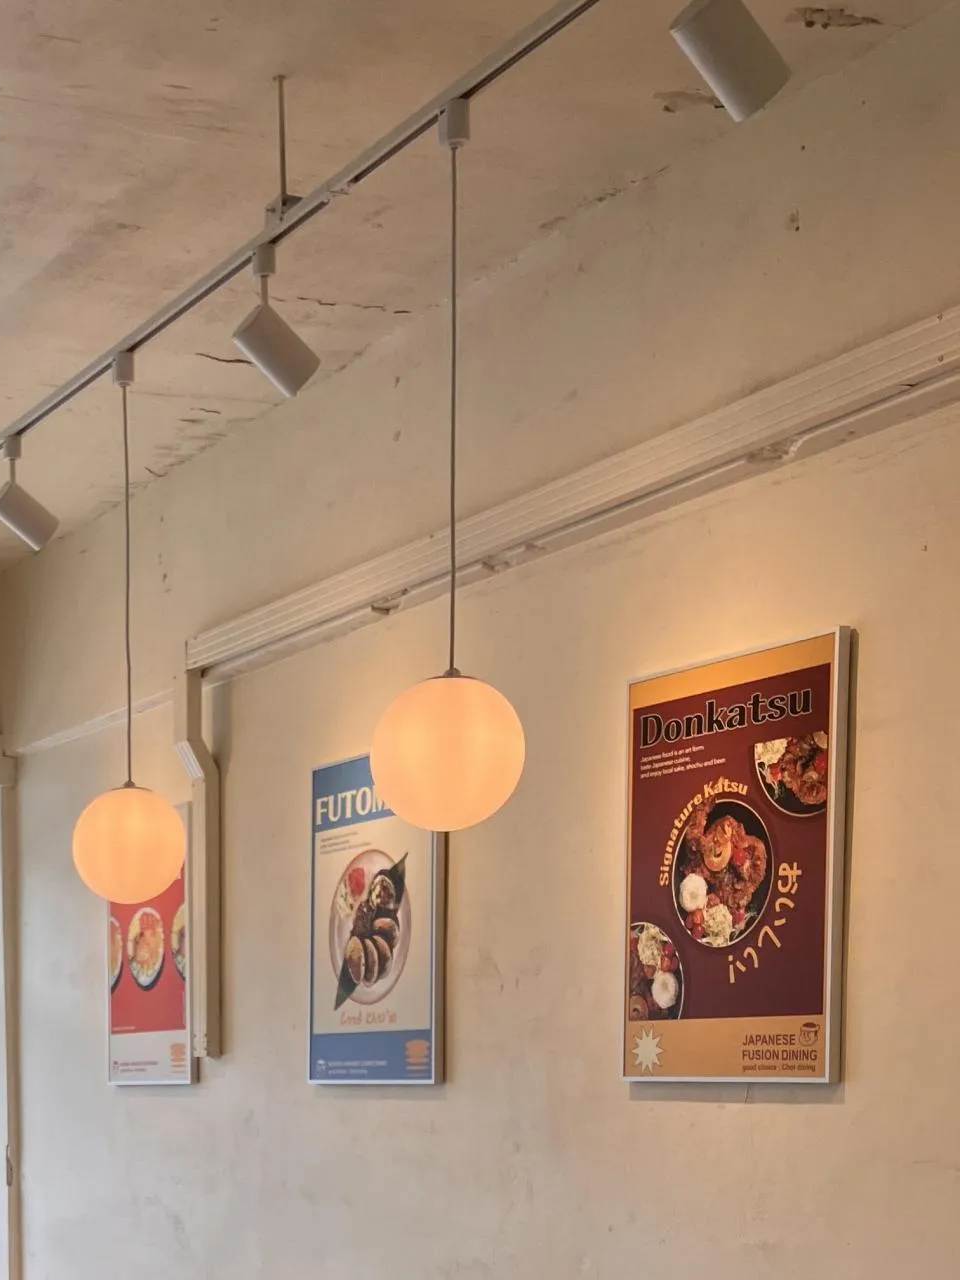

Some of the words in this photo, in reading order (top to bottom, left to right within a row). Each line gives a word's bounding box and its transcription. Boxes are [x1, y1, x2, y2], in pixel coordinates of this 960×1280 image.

[640, 688, 813, 749] Donkatsu
[659, 793, 703, 887] Signature
[703, 776, 749, 797] Katsu
[742, 1034, 796, 1046] JAPANESE
[742, 1049, 780, 1061] FUSION
[781, 1049, 818, 1061] DINING
